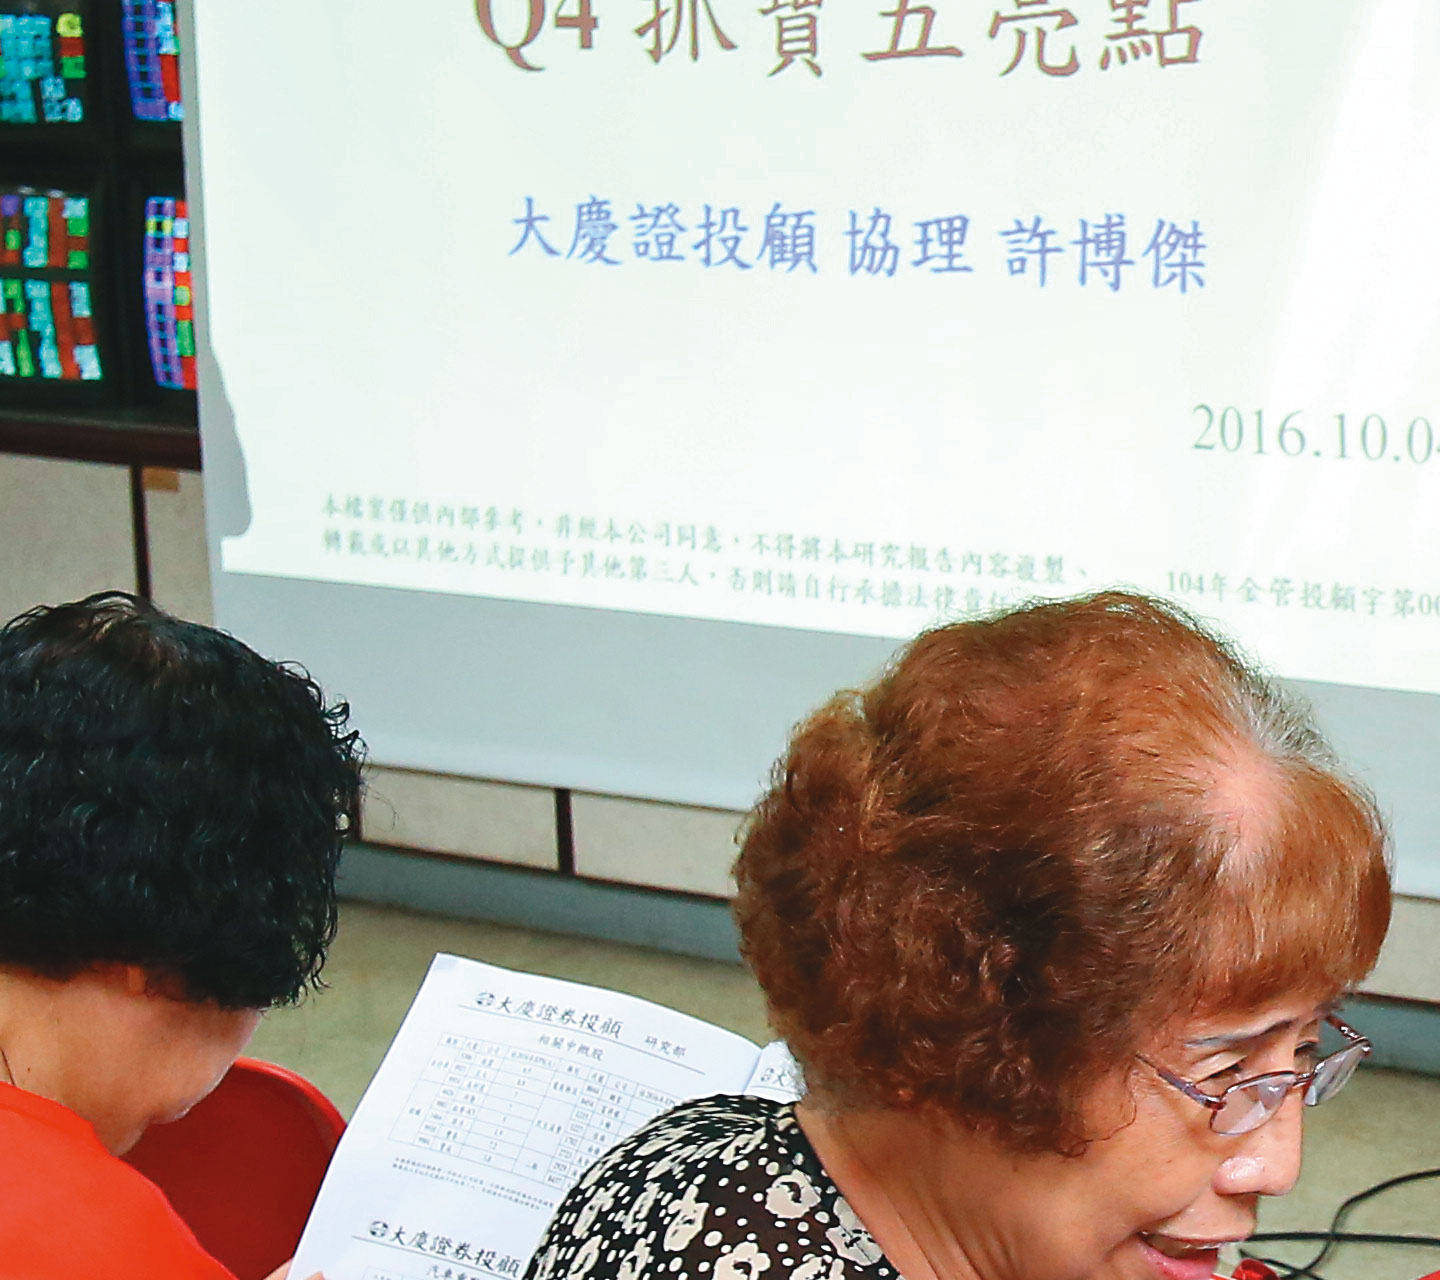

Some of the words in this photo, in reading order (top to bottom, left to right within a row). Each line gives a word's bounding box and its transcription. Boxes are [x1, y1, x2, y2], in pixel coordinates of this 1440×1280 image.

[507, 194, 819, 275] 大慶證投顧
[844, 206, 974, 279] 協理
[998, 211, 1208, 295] 許博傑
[496, 993, 623, 1040] 大慶證券投顧
[644, 1033, 688, 1059] 研究部
[391, 1225, 523, 1279] 大慶證券投顧
